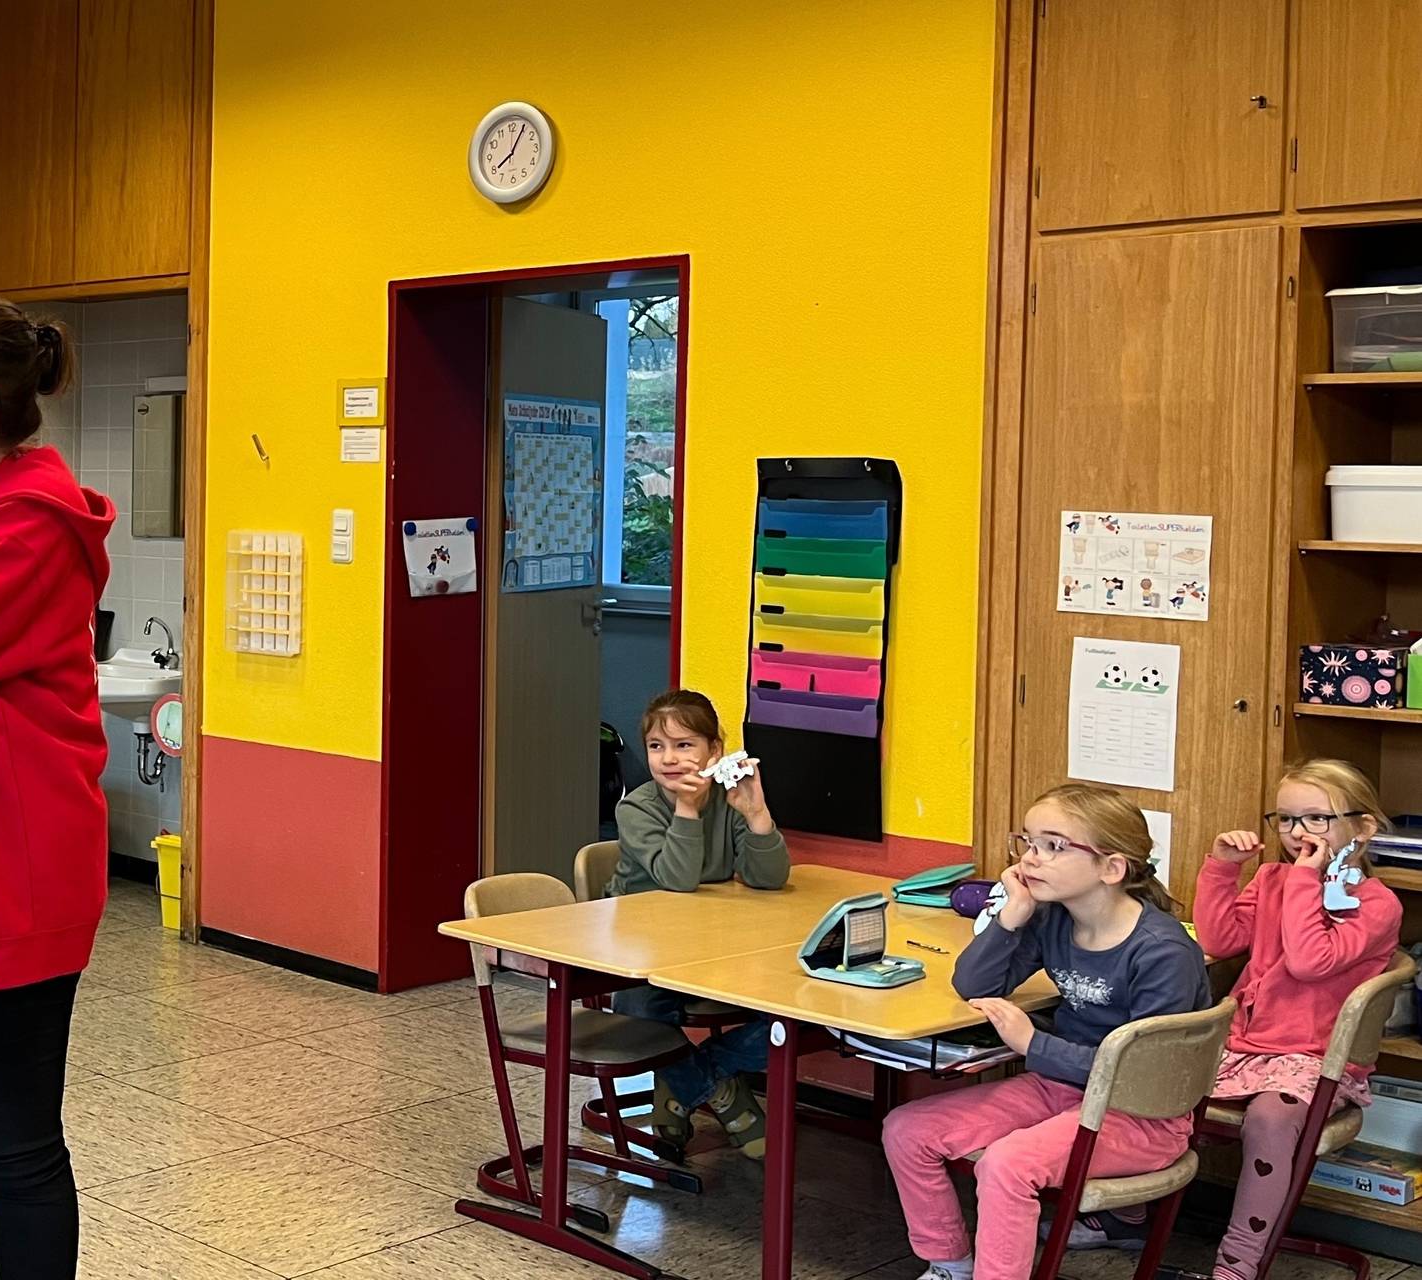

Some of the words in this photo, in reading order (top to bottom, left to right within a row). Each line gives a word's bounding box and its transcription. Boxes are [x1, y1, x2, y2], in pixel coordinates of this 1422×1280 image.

[508, 122, 517, 132] 12
[497, 129, 504, 139] 11
[529, 131, 535, 141] 2
[489, 139, 498, 149] 10
[533, 143, 539, 153] 3
[486, 153, 492, 163] 9
[529, 156, 535, 166] 4
[491, 165, 497, 175] 8
[521, 168, 527, 177] 5
[499, 173, 505, 183] 7
[510, 174, 516, 184] 6
